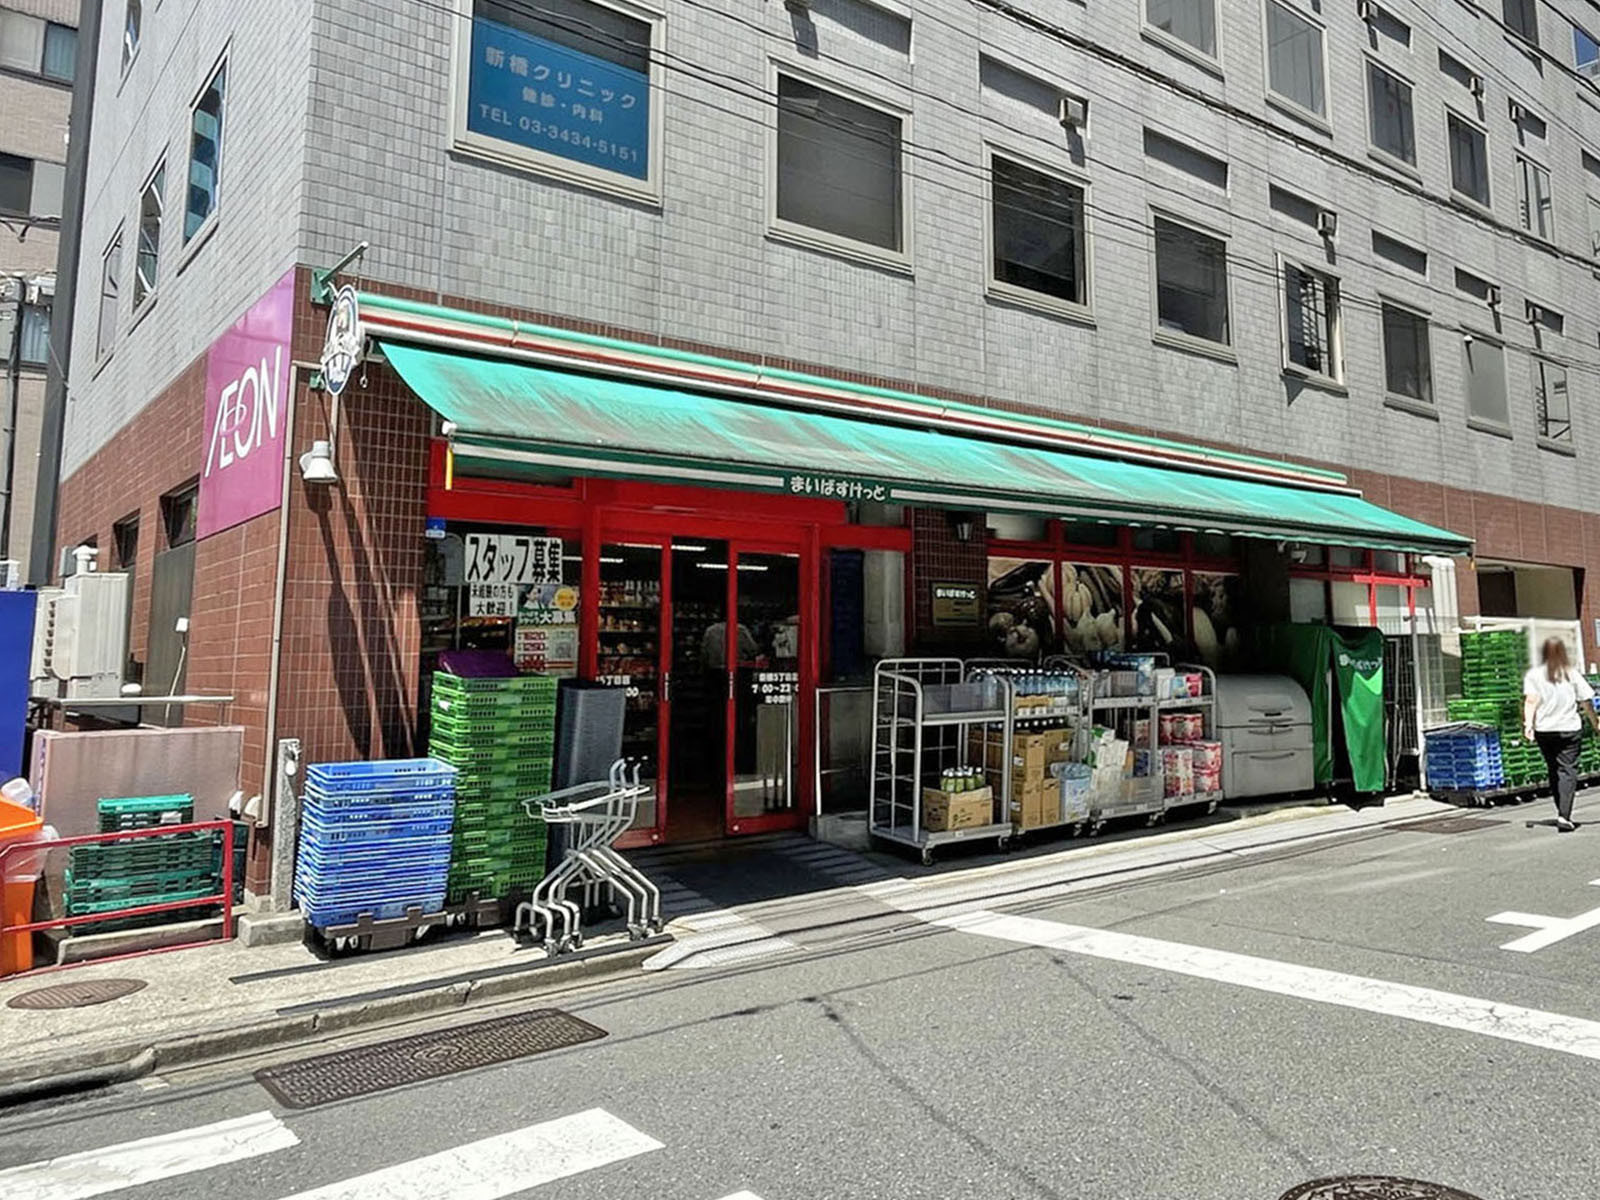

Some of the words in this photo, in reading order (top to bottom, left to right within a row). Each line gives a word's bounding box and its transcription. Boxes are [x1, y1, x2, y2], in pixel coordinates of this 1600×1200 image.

[485, 45, 637, 110] 新橋クリニック
[478, 103, 513, 126] TEL
[790, 475, 886, 501] まいばすけっと
[467, 536, 561, 583] スタッフ募集
[471, 584, 513, 600] 未経験の方も
